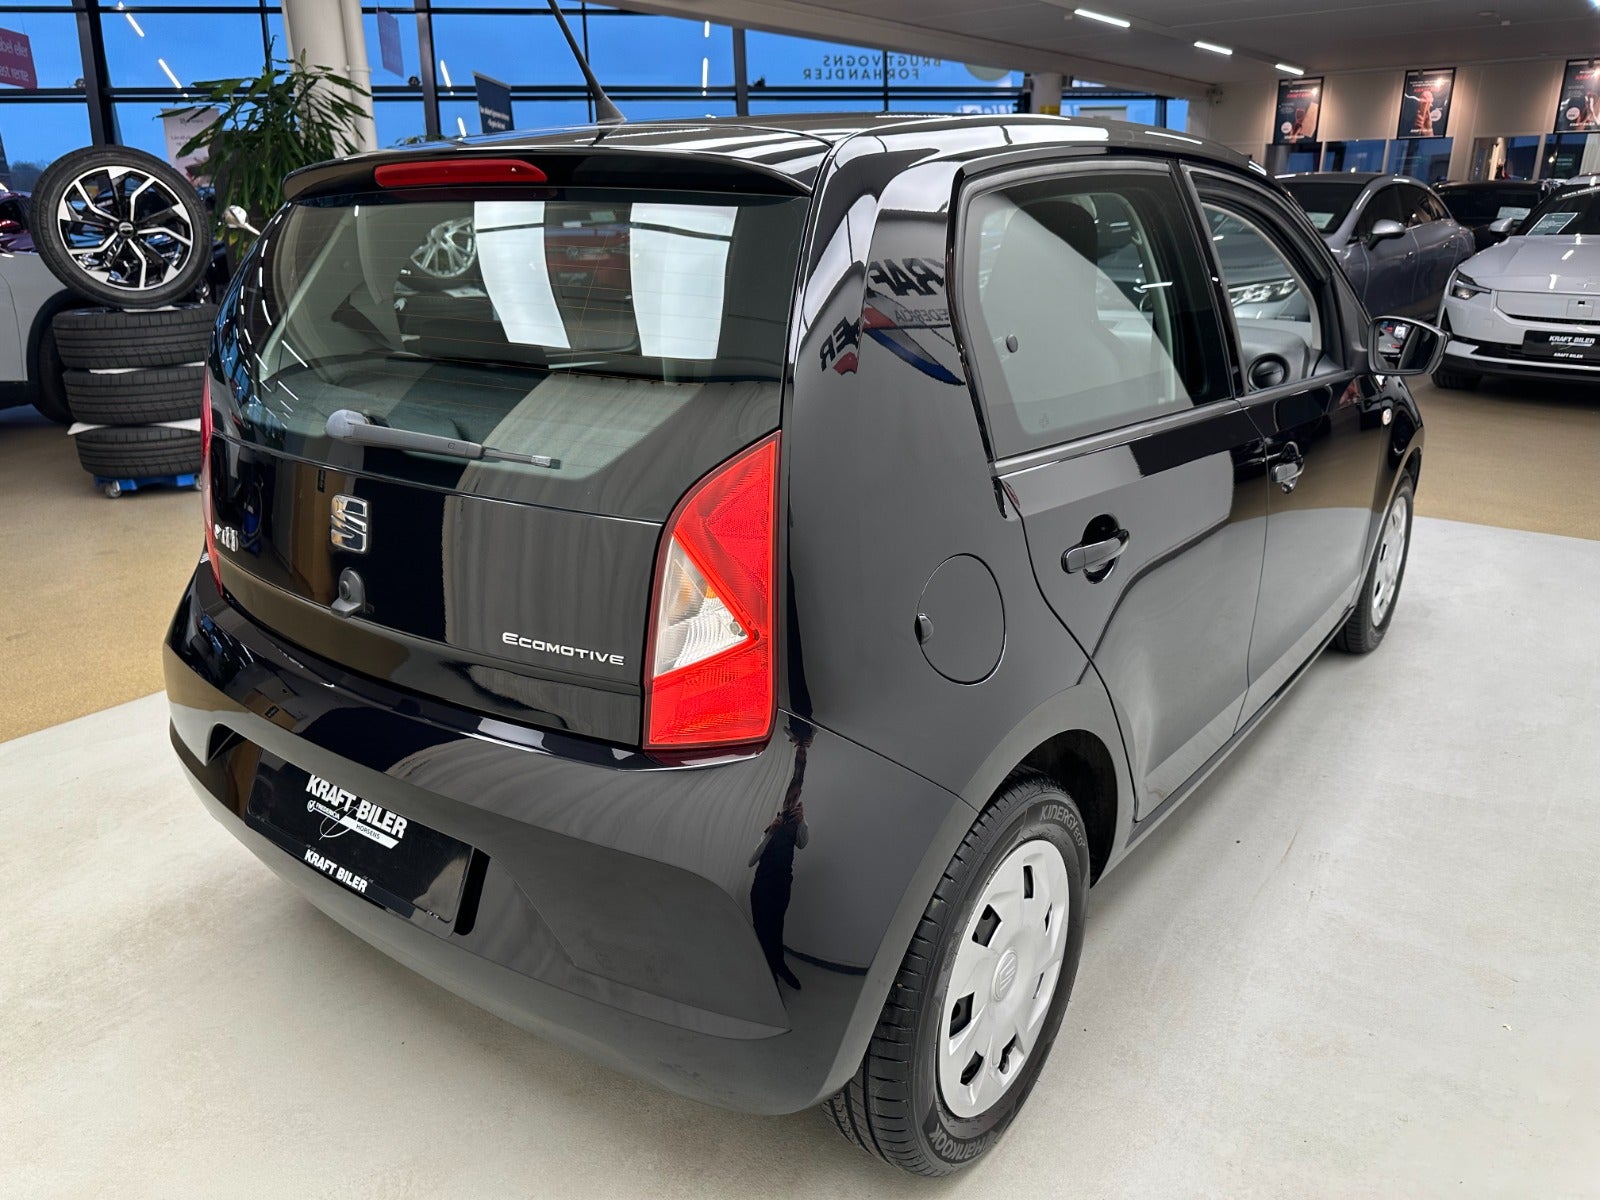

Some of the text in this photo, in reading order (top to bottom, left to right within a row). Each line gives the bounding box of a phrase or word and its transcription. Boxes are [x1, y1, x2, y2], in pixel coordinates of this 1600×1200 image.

[1549, 335, 1573, 343] KRAFT
[305, 774, 408, 839] KRAFT BILER
[356, 824, 381, 840] HORSENS
[304, 848, 368, 893] KRAFT BILER
